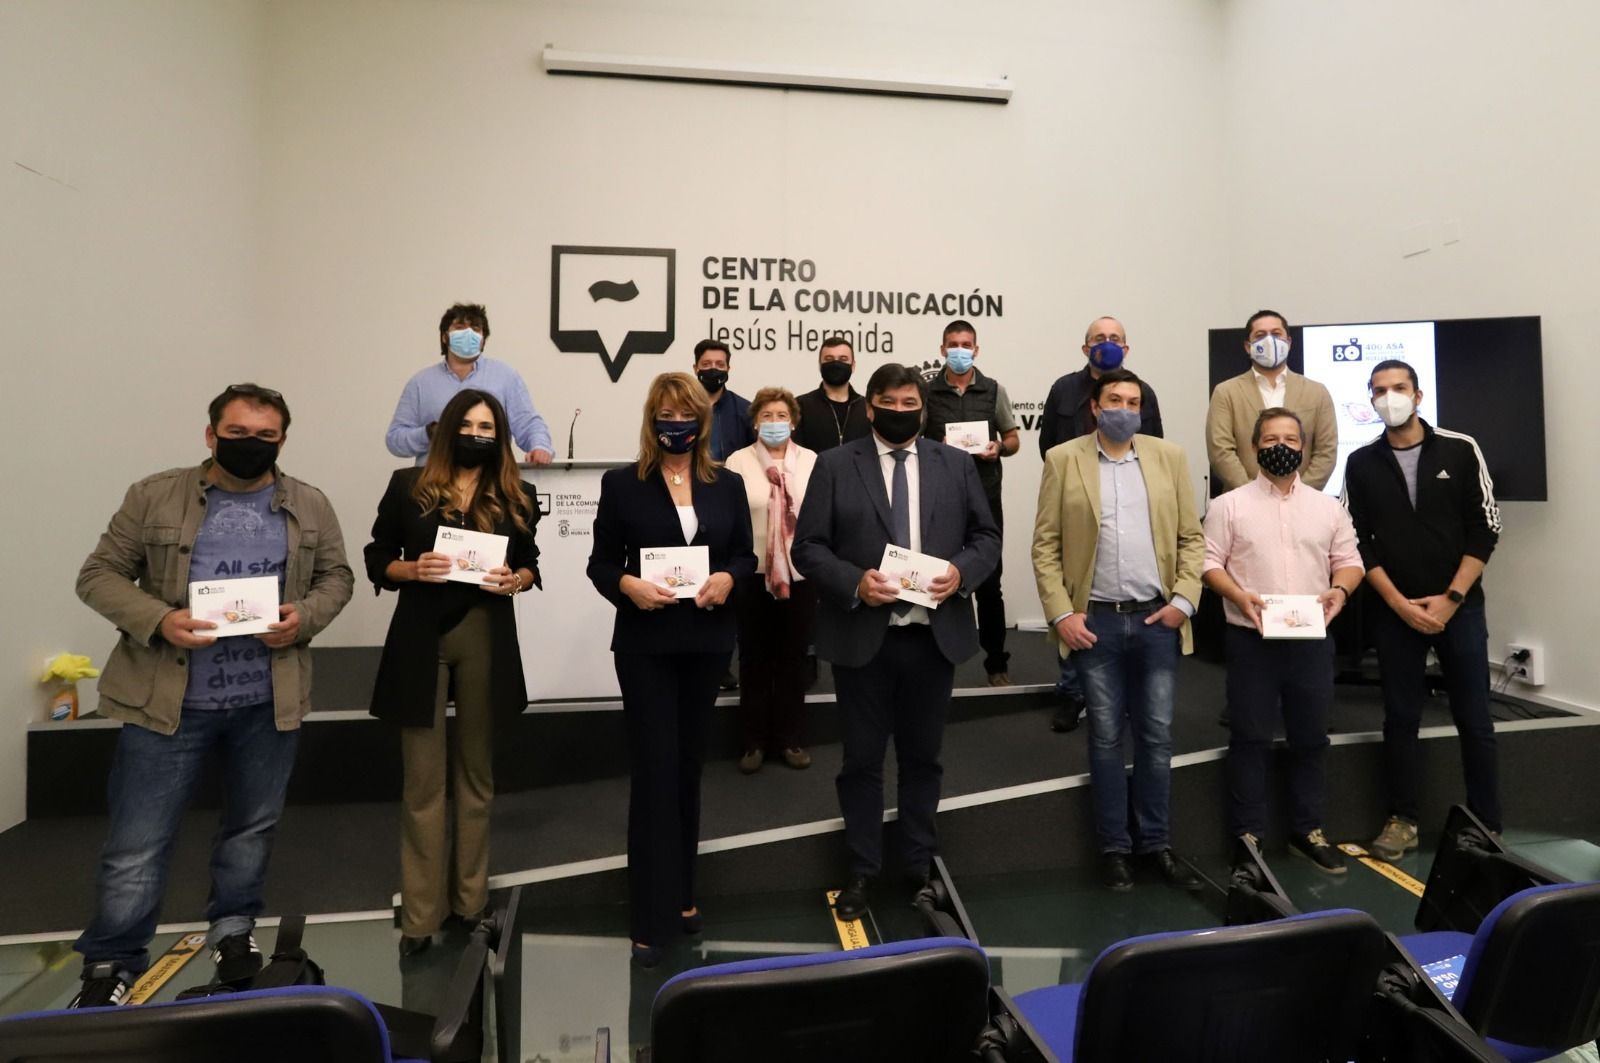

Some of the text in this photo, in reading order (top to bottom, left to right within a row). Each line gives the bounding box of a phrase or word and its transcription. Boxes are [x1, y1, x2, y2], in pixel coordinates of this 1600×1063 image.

[702, 256, 816, 282] CENTRO
[702, 286, 1003, 317] DE LA COMUNICACIÓN
[709, 318, 893, 353] Jesús Hermida
[1386, 342, 1404, 350] ASA
[1011, 400, 1035, 410] iento
[214, 557, 286, 576] All sta
[208, 667, 269, 689] drea
